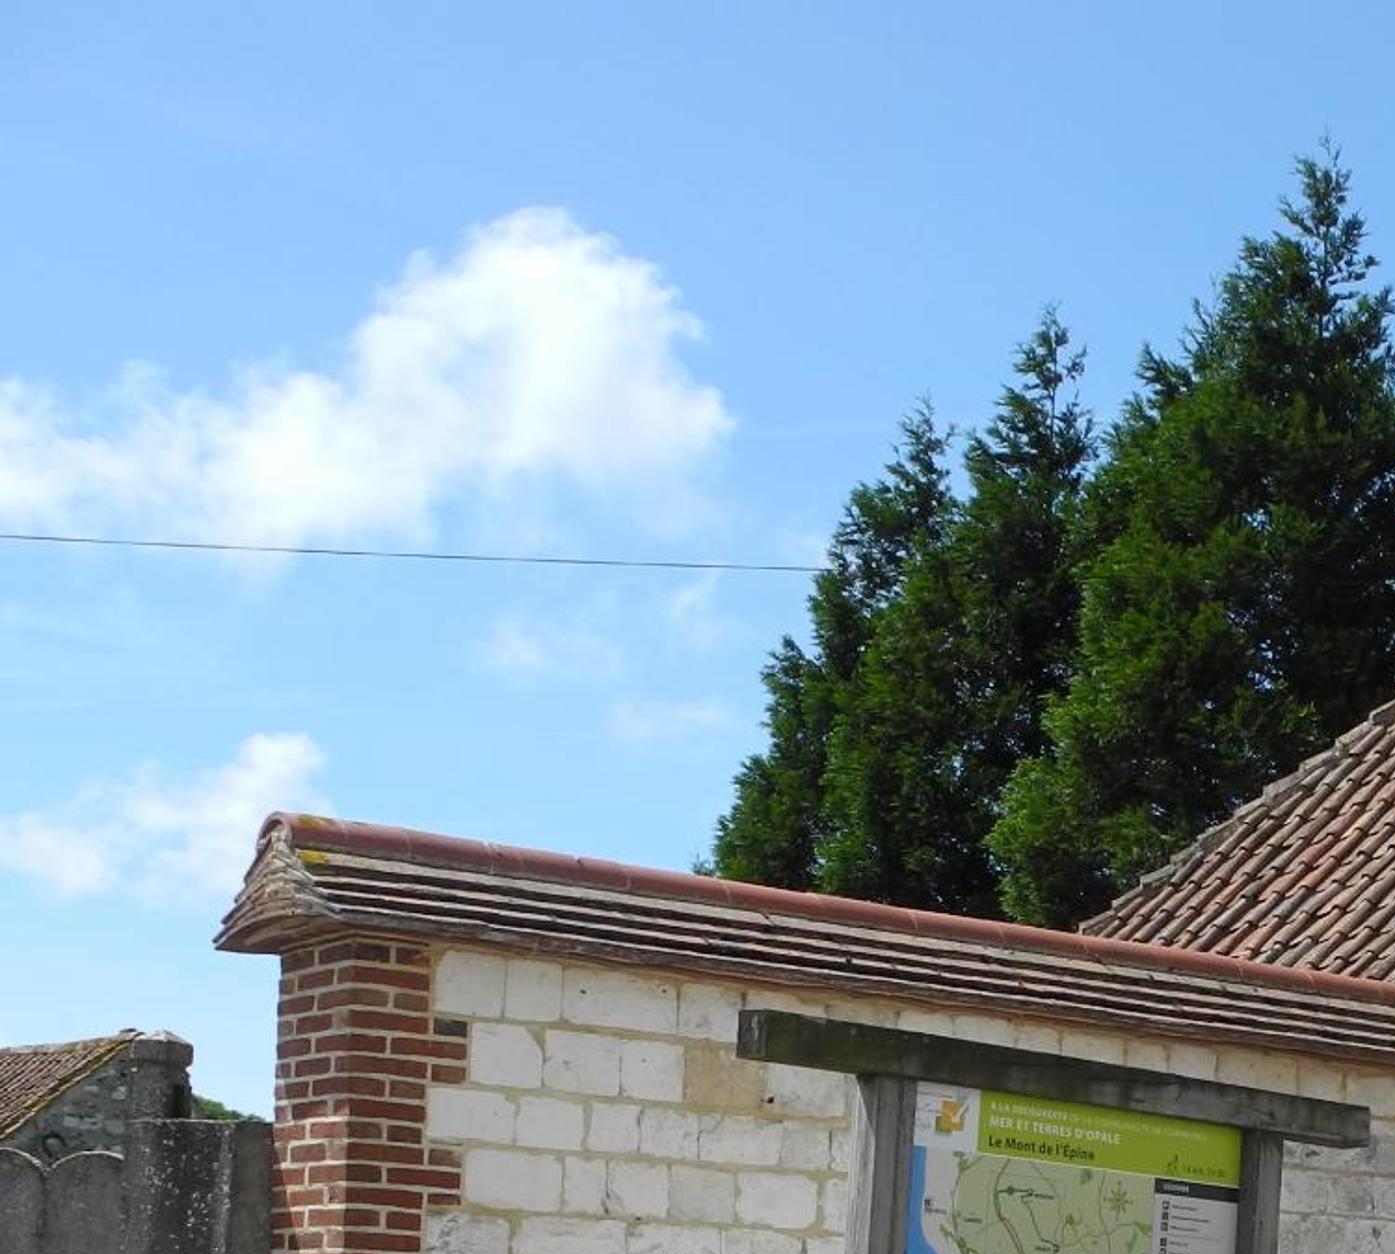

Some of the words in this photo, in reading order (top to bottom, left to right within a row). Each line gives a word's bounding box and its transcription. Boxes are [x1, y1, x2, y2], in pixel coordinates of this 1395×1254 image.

[988, 1115, 1013, 1129] MER
[1032, 1121, 1072, 1138] TERRES
[1074, 1128, 1122, 1145] D'OPALE
[989, 1135, 1002, 1149] Le
[1004, 1137, 1036, 1153] Mont
[1039, 1142, 1054, 1155] de
